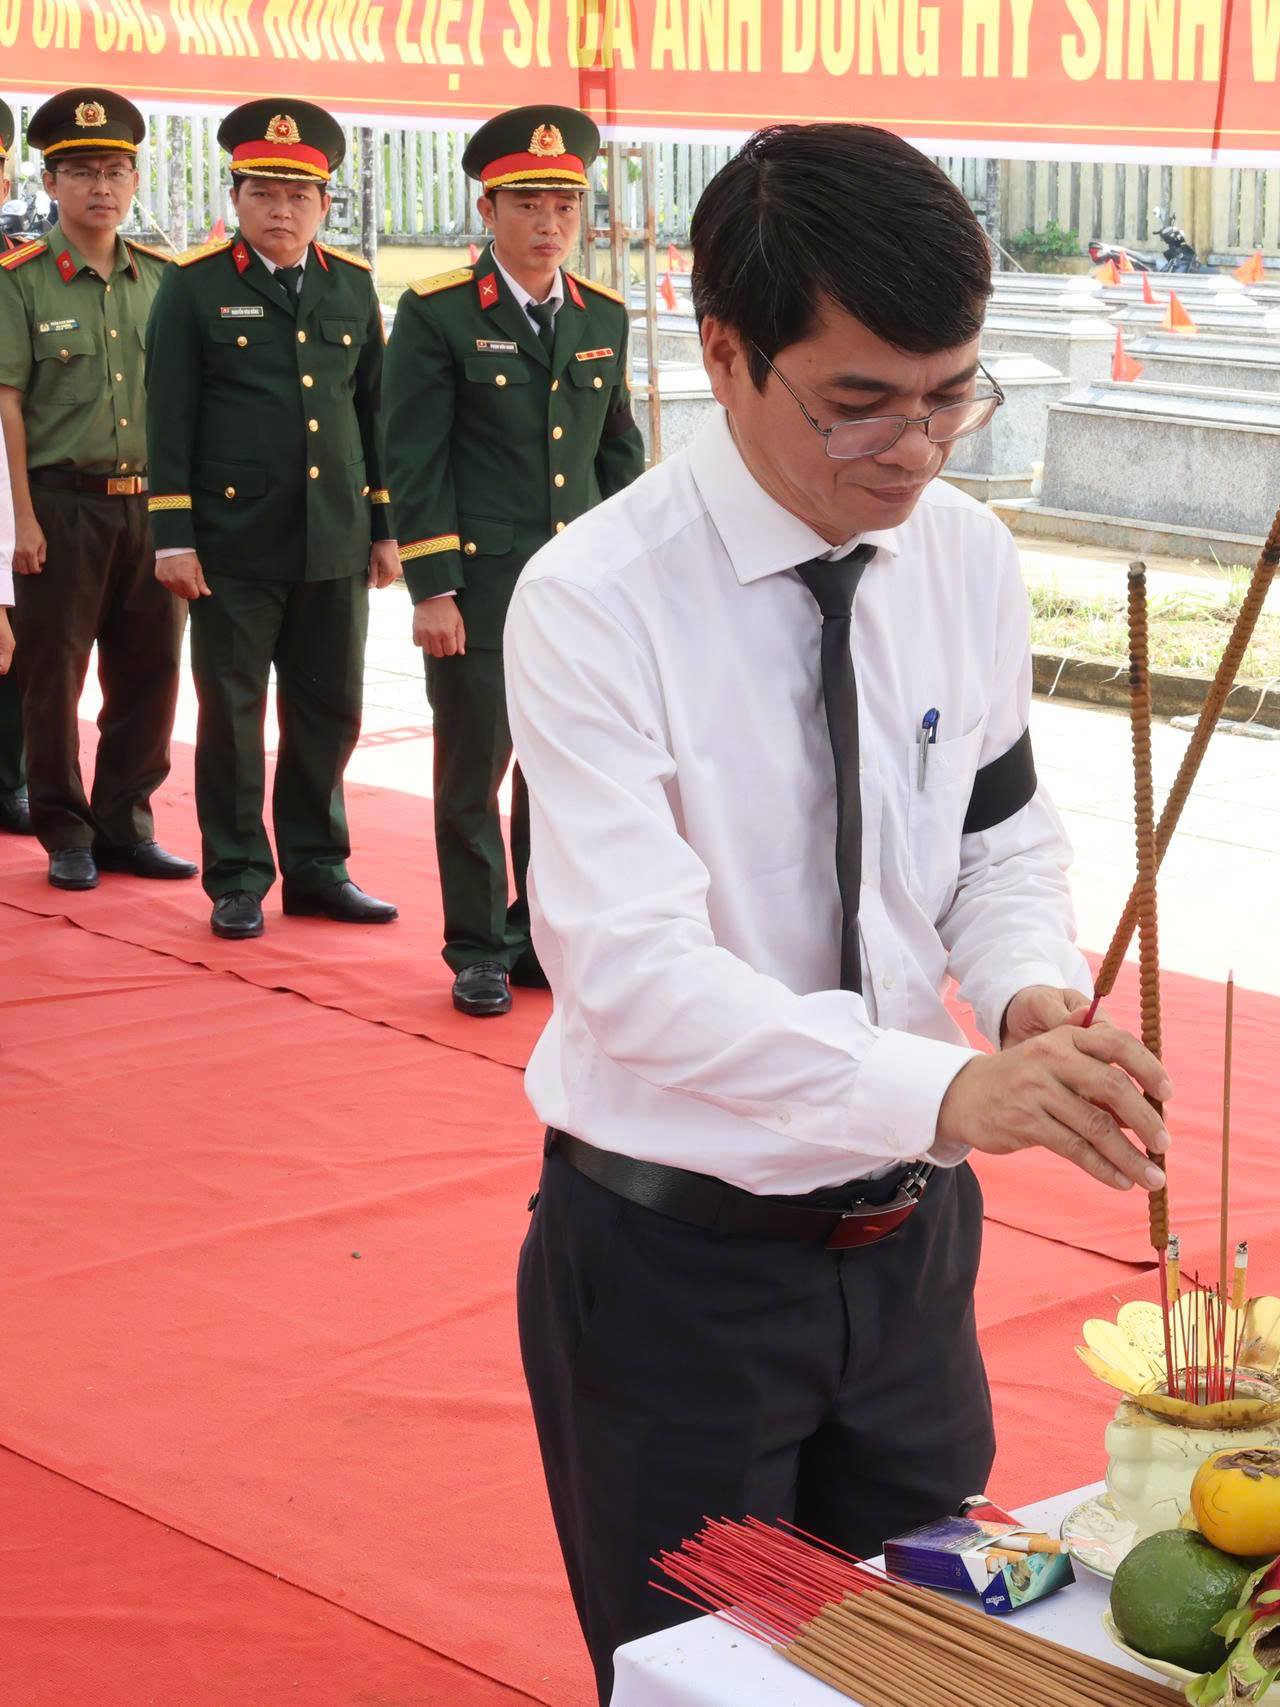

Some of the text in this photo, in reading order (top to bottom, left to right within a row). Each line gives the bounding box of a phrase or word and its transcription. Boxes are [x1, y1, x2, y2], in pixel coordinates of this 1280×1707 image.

[650, 0, 761, 72] ANH
[961, 0, 1035, 78] HY
[1060, 0, 1222, 81] SINH
